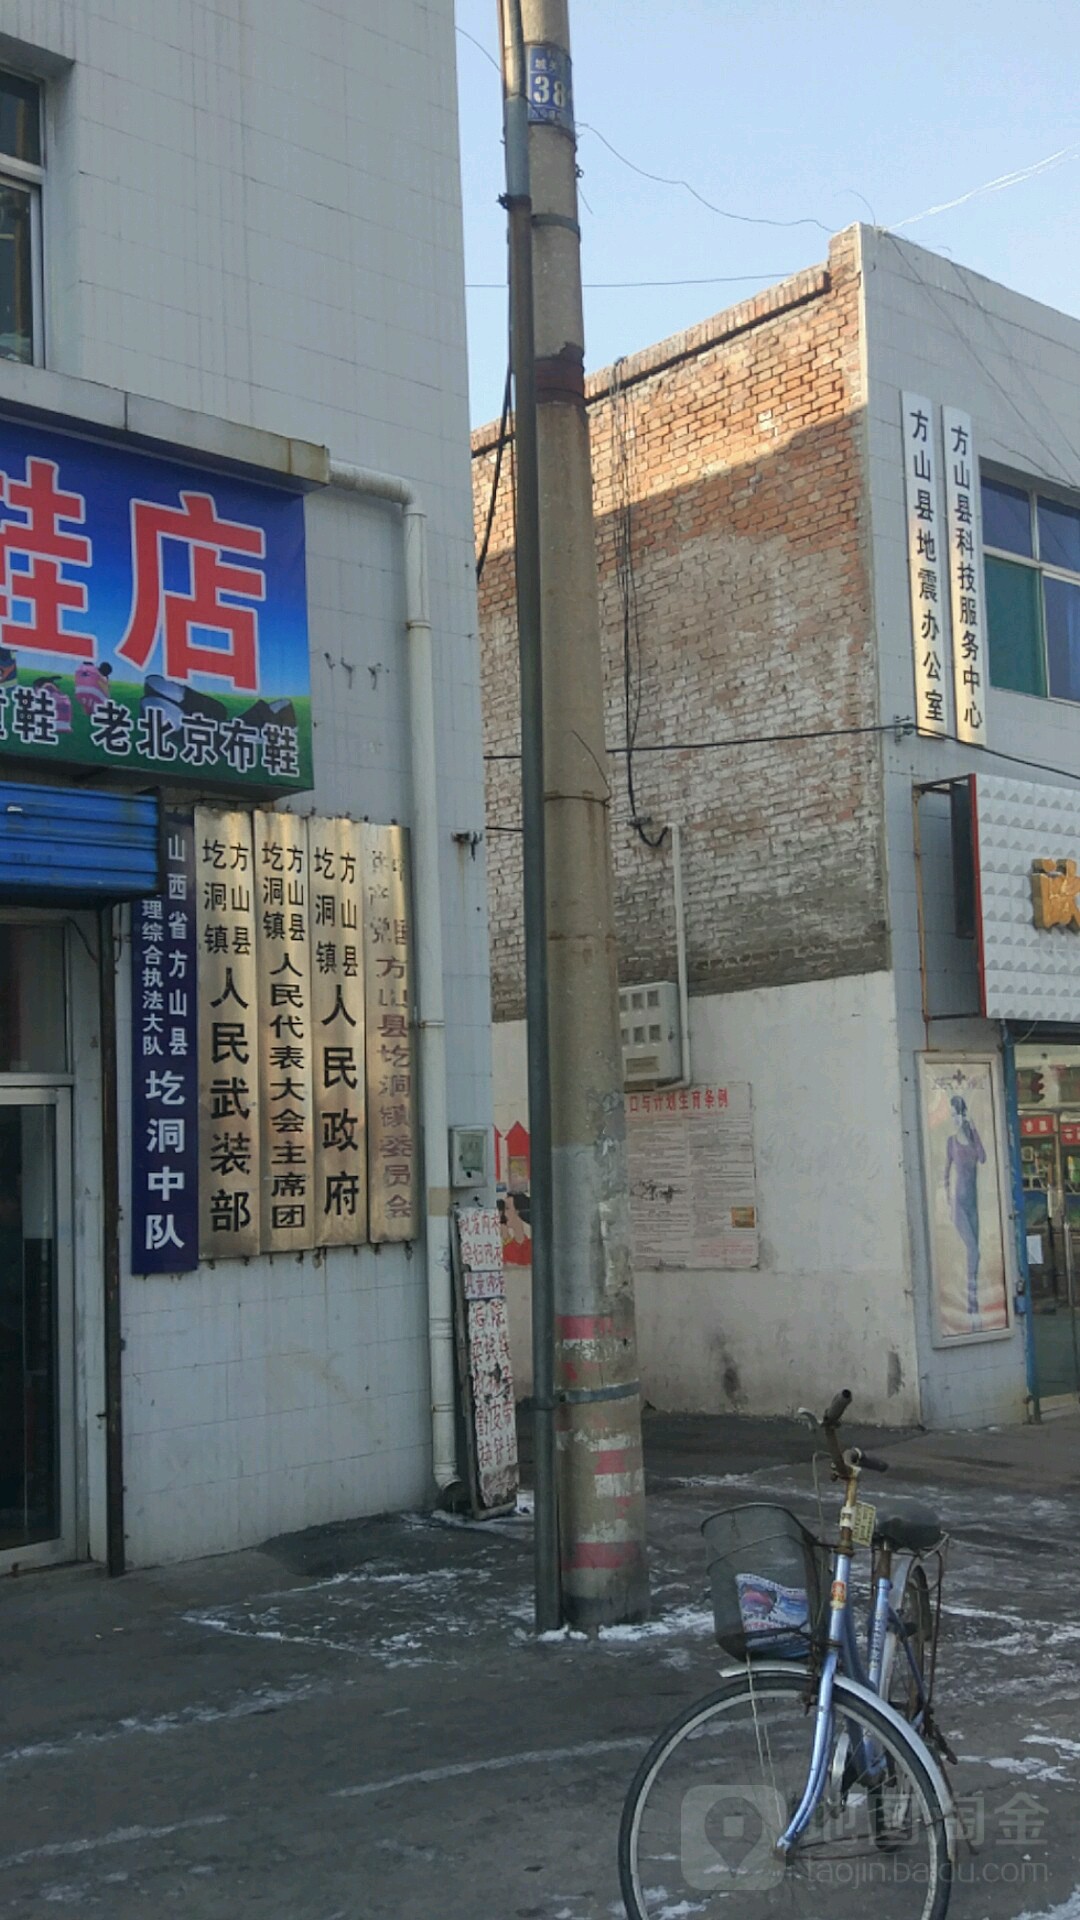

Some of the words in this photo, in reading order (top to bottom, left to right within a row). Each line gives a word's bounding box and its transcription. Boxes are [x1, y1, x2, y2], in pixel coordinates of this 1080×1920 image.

[533, 76, 564, 107] 38
[910, 410, 944, 722] 方山县地震办公室
[951, 425, 983, 729] 方山县科技服务中心
[0, 687, 58, 745] 鞋
[91, 700, 300, 777] 老北京布鞋
[142, 897, 164, 1056] 理综合执法大队
[167, 833, 189, 1056] 山西省方山县
[230, 844, 252, 956] 方山县
[286, 847, 306, 942] 方山县
[340, 852, 359, 978] 方山县
[145, 1069, 185, 1250] 圪洞中队
[210, 968, 251, 1233] 人民武装部
[269, 952, 306, 1229] 人民代表大会主席团
[321, 984, 360, 1217] 人民政府
